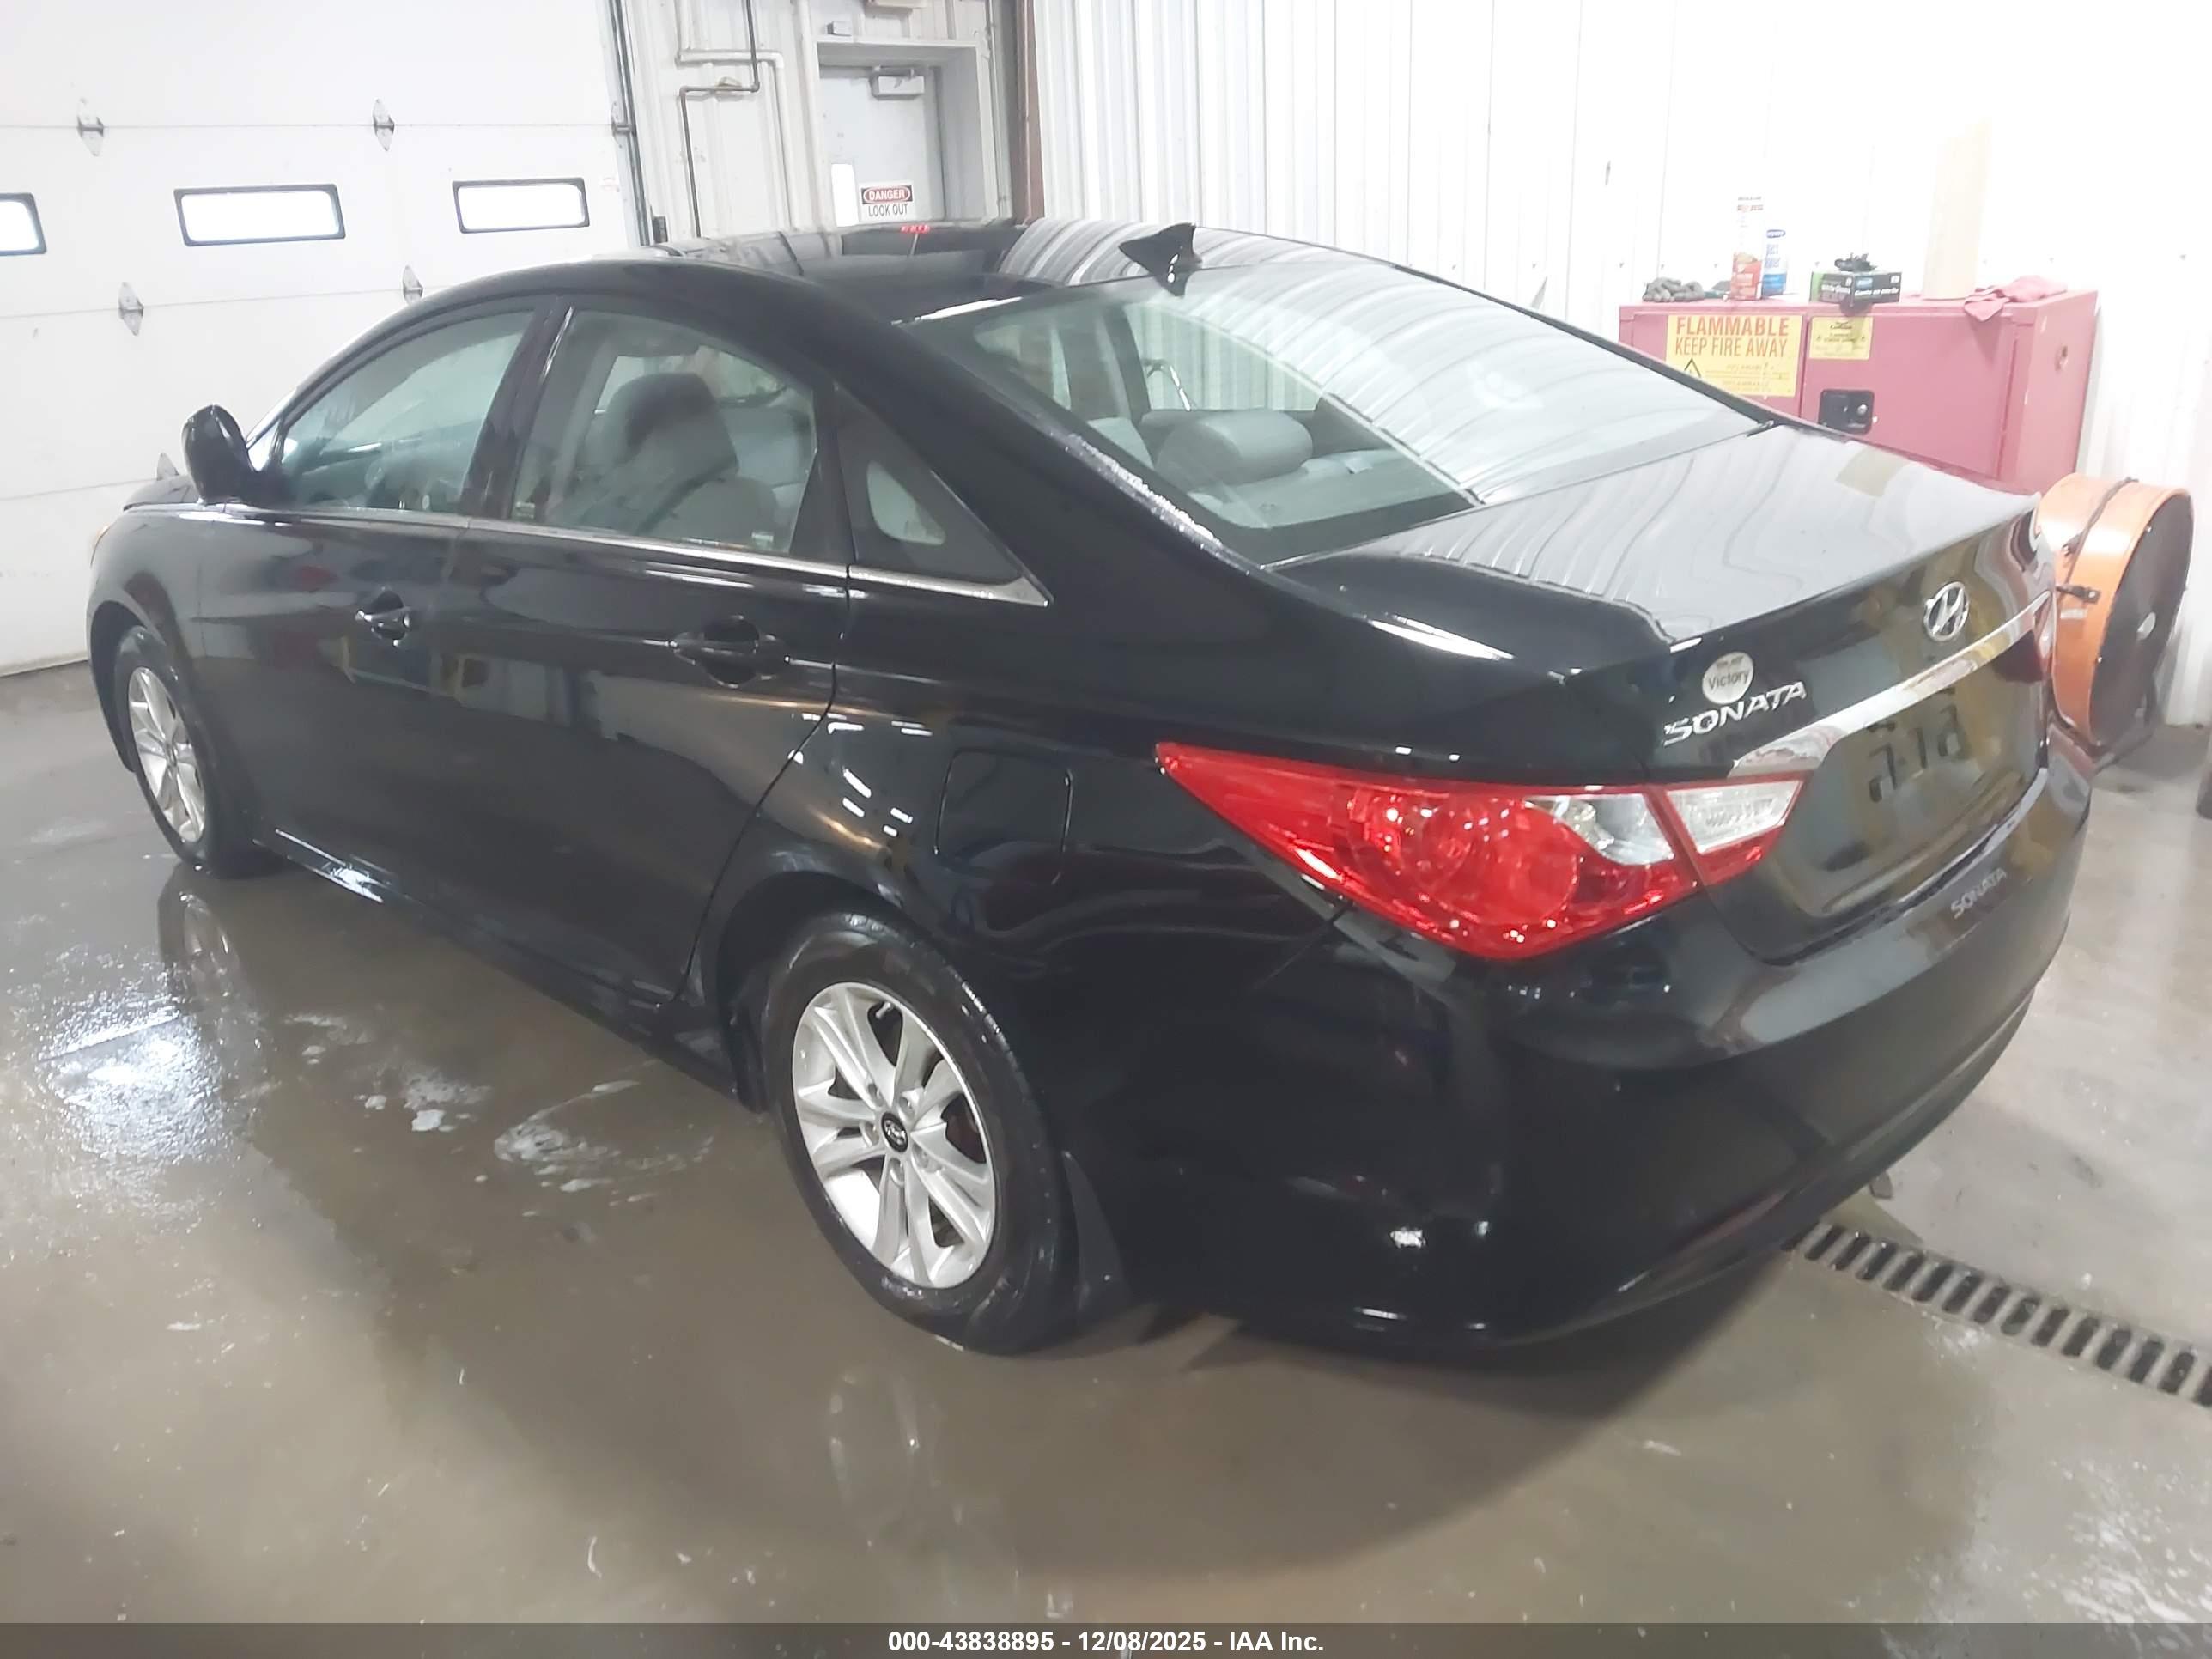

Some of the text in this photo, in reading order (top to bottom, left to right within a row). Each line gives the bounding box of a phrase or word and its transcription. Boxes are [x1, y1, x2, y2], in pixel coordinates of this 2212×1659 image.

[869, 189, 905, 200] DANGER
[868, 203, 908, 216] LOOK OUT
[1676, 316, 1790, 337] FLAMMABLE
[1675, 336, 1787, 357] KEEP FIRE AWAY
[1708, 670, 1750, 690] Victory
[1662, 681, 1807, 747] SONATA
[1950, 867, 2007, 920] SONATA
